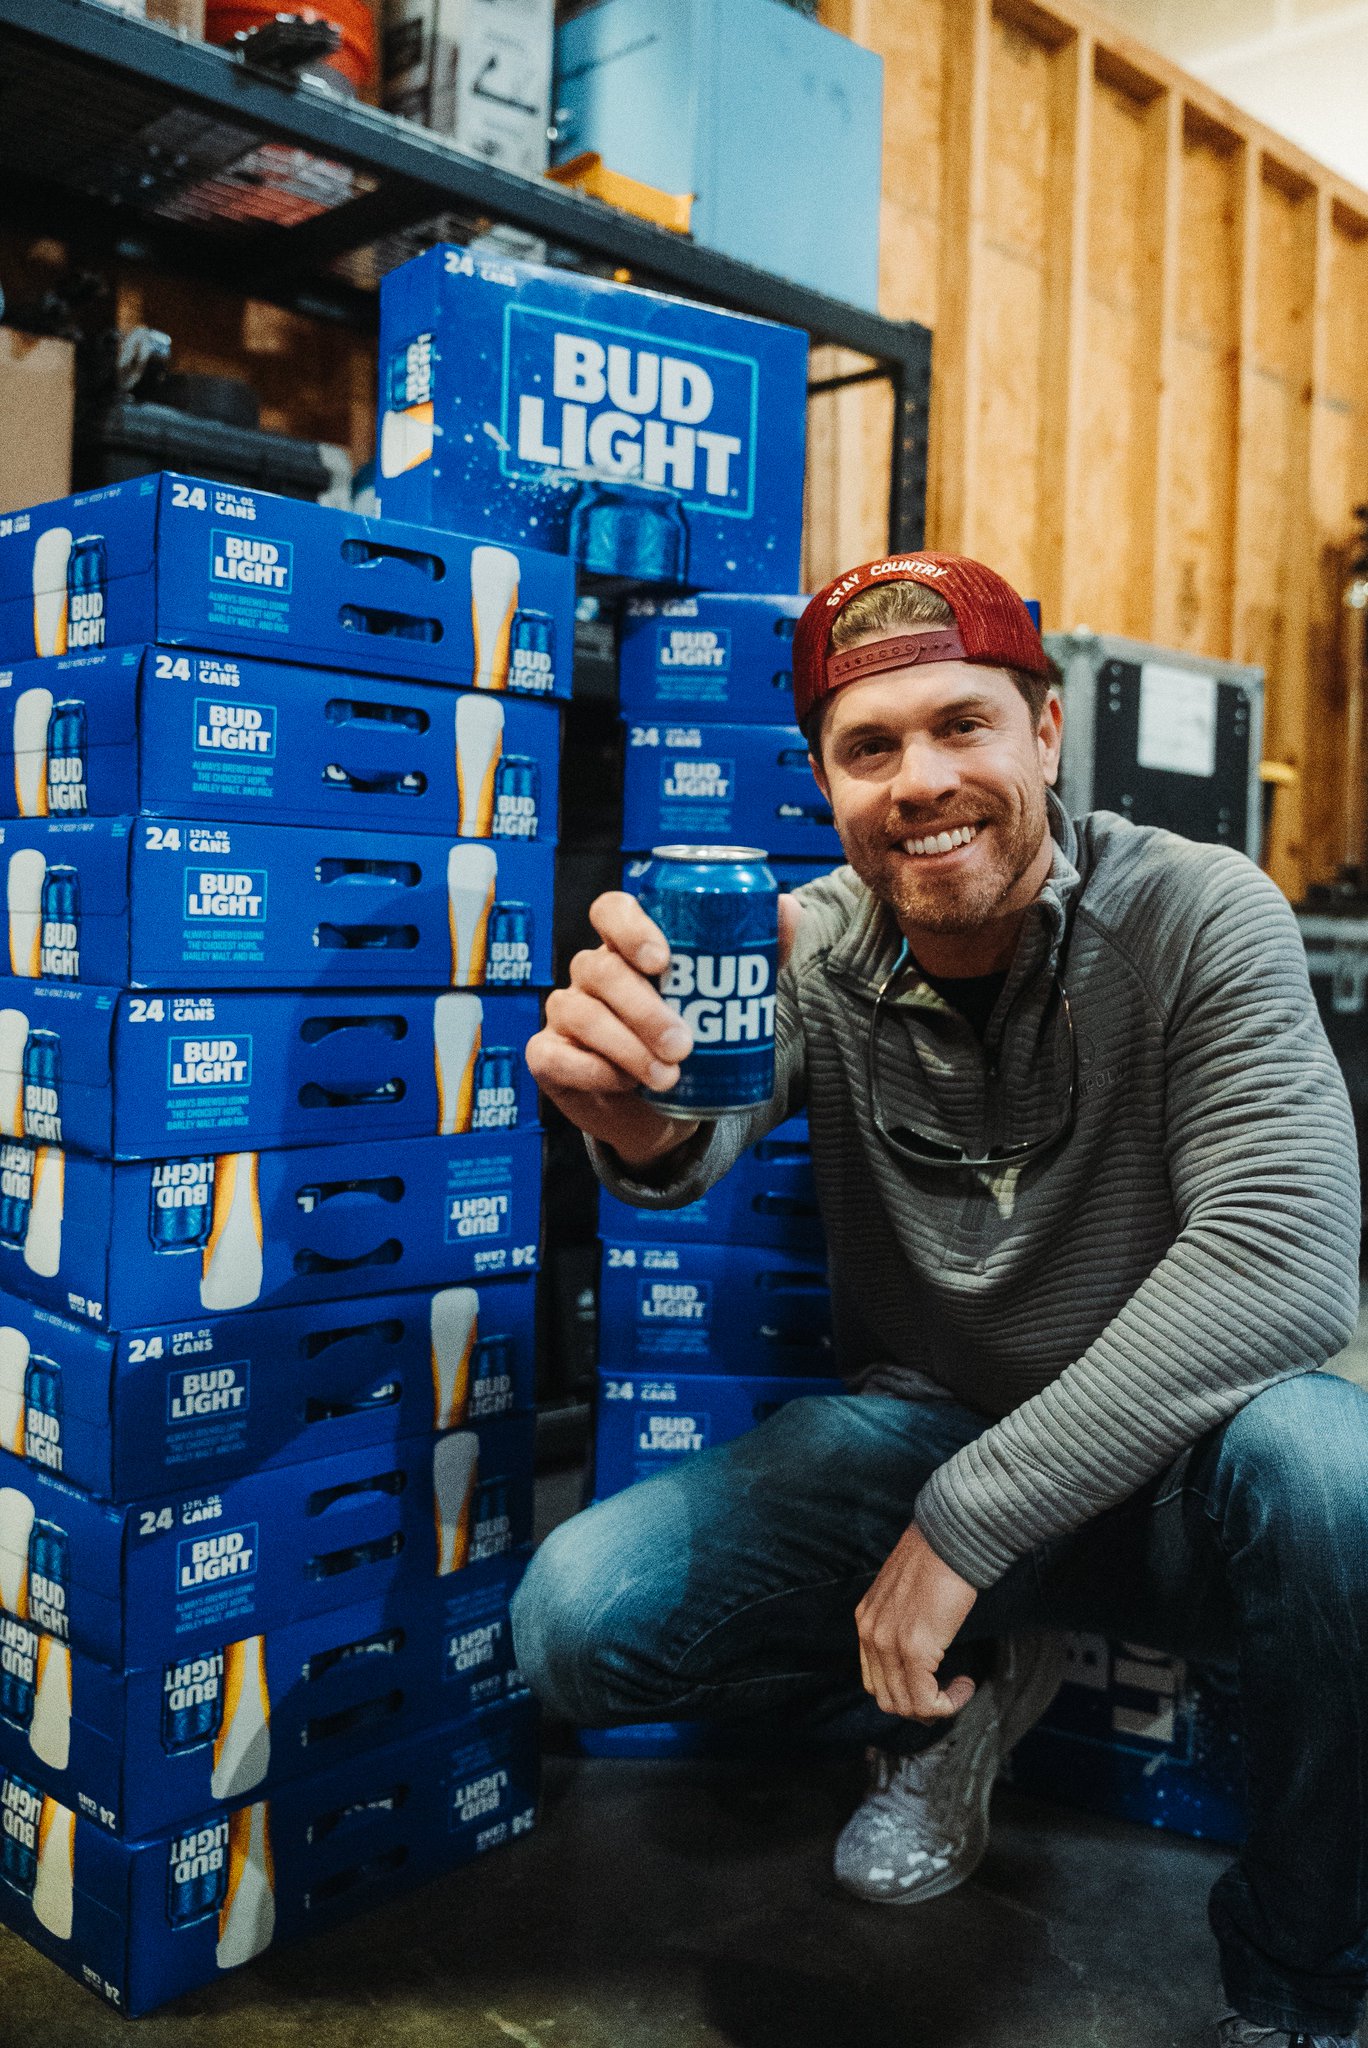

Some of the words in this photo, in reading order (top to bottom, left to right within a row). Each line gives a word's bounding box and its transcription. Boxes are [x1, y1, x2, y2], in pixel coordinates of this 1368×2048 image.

[444, 251, 474, 277] 24
[554, 332, 714, 425] BUD
[518, 394, 742, 497] LIGHT
[172, 484, 207, 510] 24
[215, 501, 256, 520] CANS
[226, 537, 279, 565] BUD
[215, 556, 288, 588] LIGHT
[826, 573, 860, 606] STAY
[870, 560, 948, 578] COUNTRY
[71, 592, 103, 621] BUD
[68, 618, 105, 647] LIGHT
[156, 656, 190, 680] 24
[514, 649, 551, 673] BUD
[661, 647, 726, 666] LIGHT
[199, 670, 240, 687] CANS
[209, 705, 262, 730] BUD
[198, 725, 271, 752] LIGHT
[631, 727, 659, 747] 24
[50, 757, 82, 783] BUD
[48, 784, 87, 810] LIGHT
[664, 778, 729, 797] LIGHT
[498, 795, 535, 816] BUD
[146, 827, 181, 851] 24
[189, 839, 230, 853] CANS
[200, 873, 252, 895] BUD
[189, 894, 262, 916] LIGHT
[44, 922, 77, 949] BUD
[41, 949, 79, 976] LIGHT
[491, 942, 529, 962] BUD
[660, 953, 769, 998] BUD
[129, 999, 165, 1023] 24
[173, 1008, 215, 1021] CANS
[183, 1041, 237, 1063] BUD
[173, 1061, 247, 1084] LIGHT
[25, 1085, 58, 1115] BUD
[478, 1087, 515, 1107] BUD
[24, 1110, 62, 1141] LIGHT
[2, 1170, 30, 1200] BUD
[152, 1162, 214, 1187] LIGHT
[157, 1183, 208, 1208] BUD
[450, 1196, 508, 1220] LIGHT
[457, 1214, 499, 1236] BUD
[512, 1245, 536, 1267] 24
[608, 1248, 636, 1268] 24
[651, 1284, 698, 1301] BUD
[642, 1300, 705, 1318] LIGHT
[128, 1336, 164, 1363] 24
[173, 1338, 213, 1356] CANS
[183, 1369, 236, 1396] BUD
[606, 1381, 634, 1400] 24
[172, 1386, 244, 1418] LIGHT
[28, 1407, 60, 1444] BUD
[649, 1416, 696, 1433] BUD
[26, 1432, 63, 1472] LIGHT
[639, 1432, 704, 1450] LIGHT
[139, 1507, 174, 1535] 24
[183, 1504, 222, 1525] CANS
[192, 1532, 244, 1564] BUD
[182, 1549, 253, 1587] LIGHT
[31, 1572, 65, 1611] BUD
[29, 1596, 69, 1638] LIGHT
[0, 1618, 39, 1659] LIGHT
[449, 1622, 501, 1657] LIGHT
[2, 1645, 33, 1683] BUD
[455, 1641, 494, 1671] BUD
[164, 1654, 223, 1691] LIGHT
[169, 1677, 218, 1711] BUD
[454, 1770, 508, 1808] LIGHT
[1, 1779, 42, 1826] LIGHT
[461, 1789, 500, 1821] BUD
[3, 1808, 35, 1850] BUD
[100, 1806, 115, 1830] 24
[170, 1822, 229, 1865] LIGHT
[174, 1847, 223, 1884] BUD
